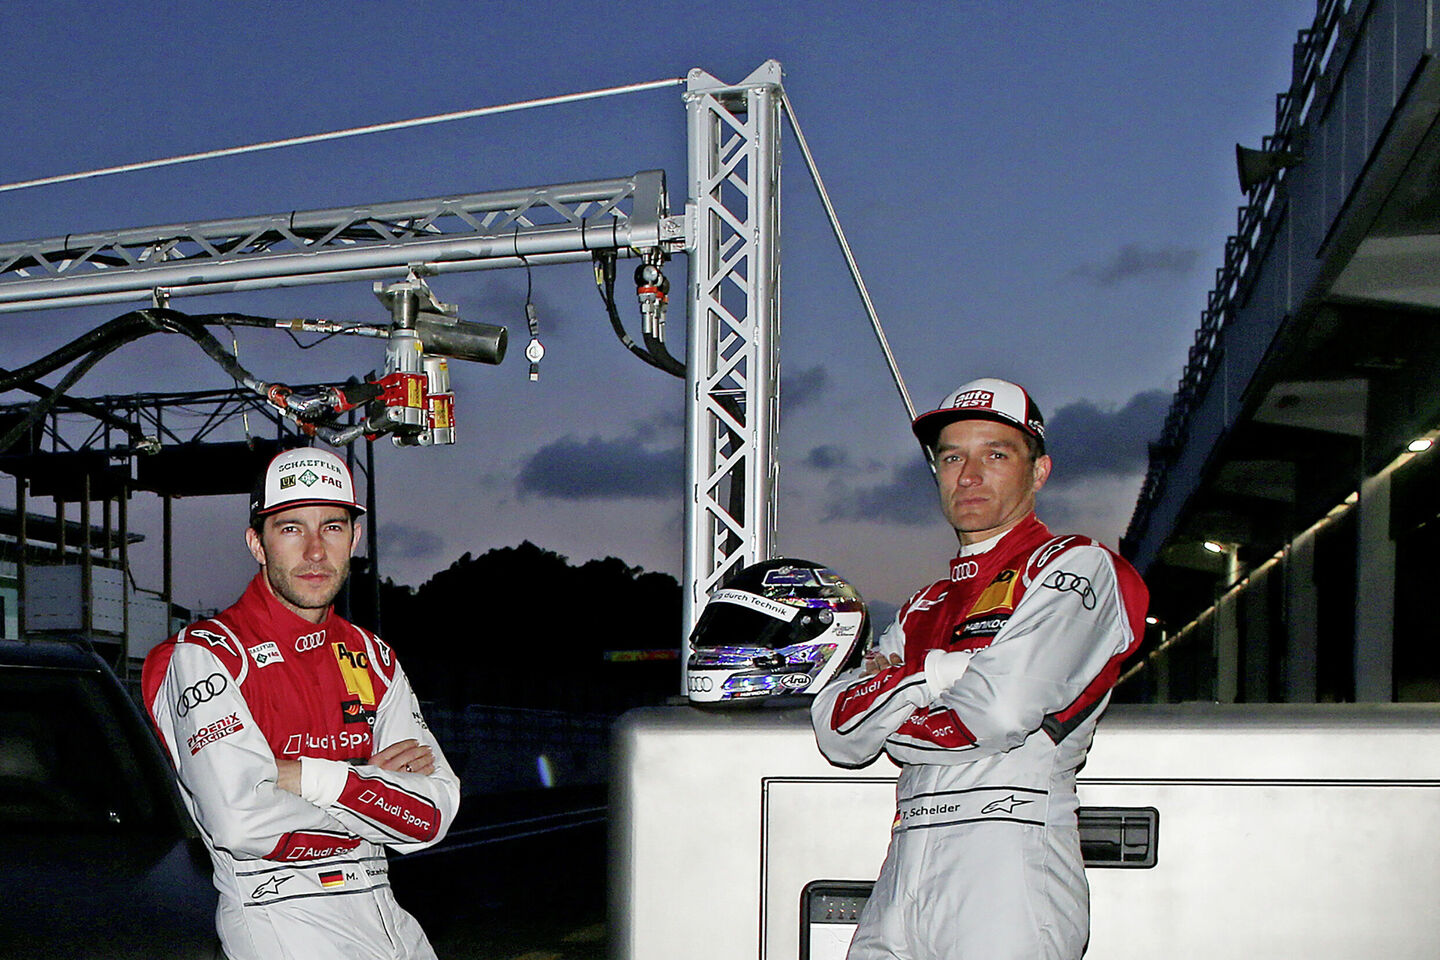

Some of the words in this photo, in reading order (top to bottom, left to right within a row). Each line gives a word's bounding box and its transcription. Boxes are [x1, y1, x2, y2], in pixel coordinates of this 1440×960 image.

[750, 596, 788, 616] Technik
[787, 674, 808, 685] Arai
[374, 796, 402, 817] Audi
[401, 808, 431, 831] Sport
[304, 847, 332, 858] Audi
[345, 872, 359, 881] M.
